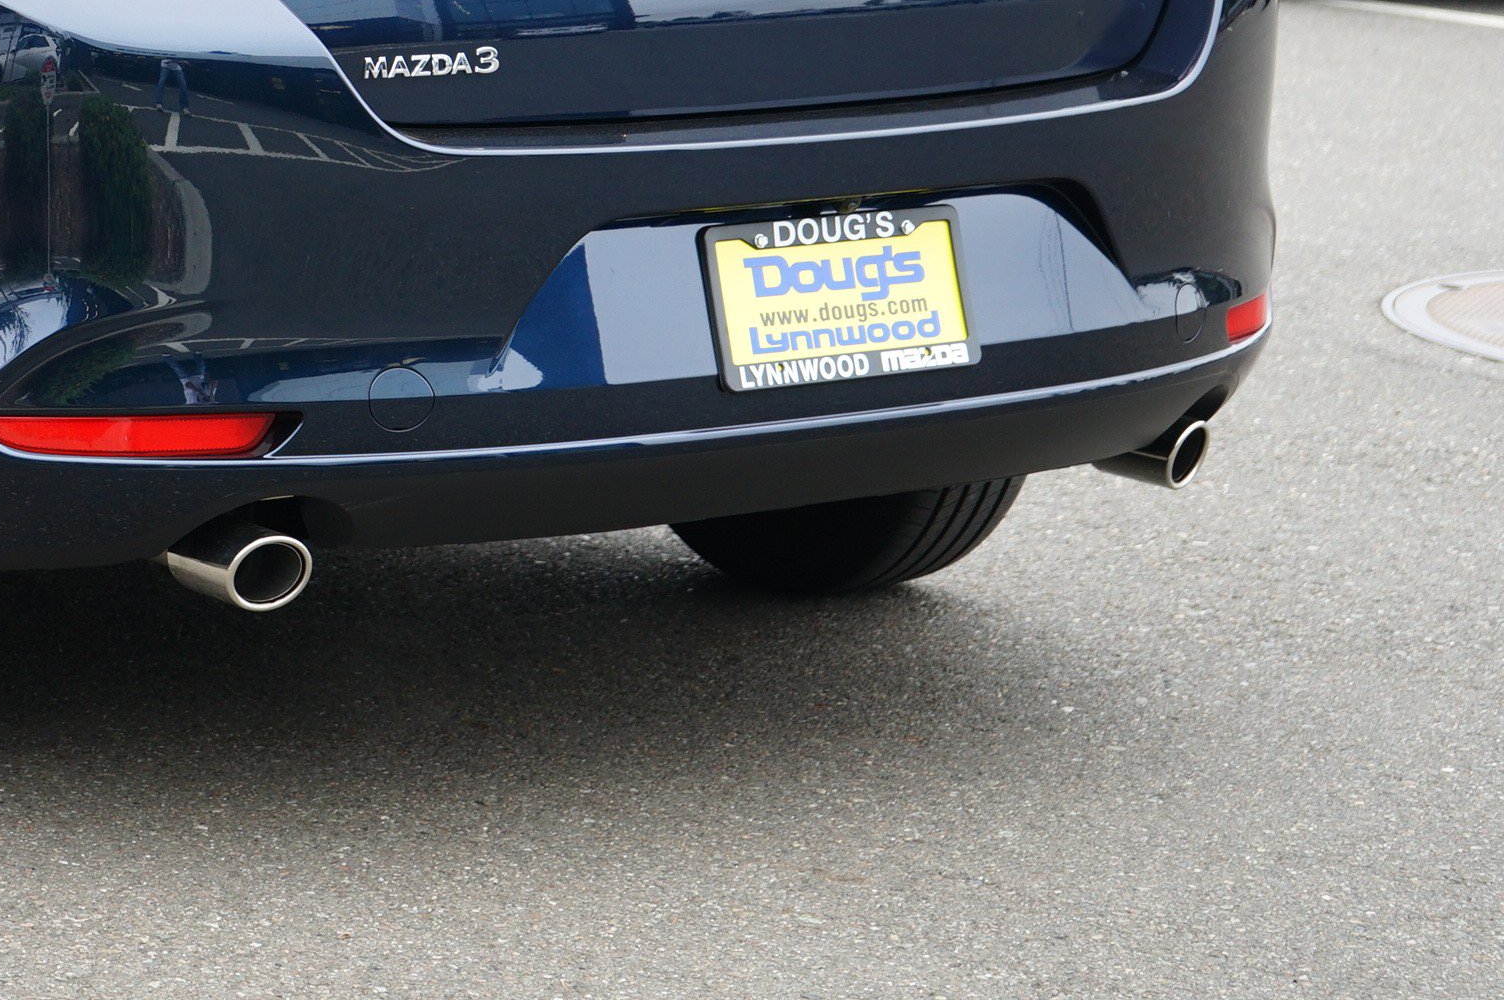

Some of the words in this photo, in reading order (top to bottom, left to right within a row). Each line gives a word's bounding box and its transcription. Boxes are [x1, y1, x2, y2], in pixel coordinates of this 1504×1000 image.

[364, 46, 500, 80] MAZDA3
[773, 210, 896, 248] DOUG'S
[760, 297, 929, 327] www.dougs.com
[748, 310, 942, 356] Lynnwood
[739, 354, 870, 390] LYNNWOOD
